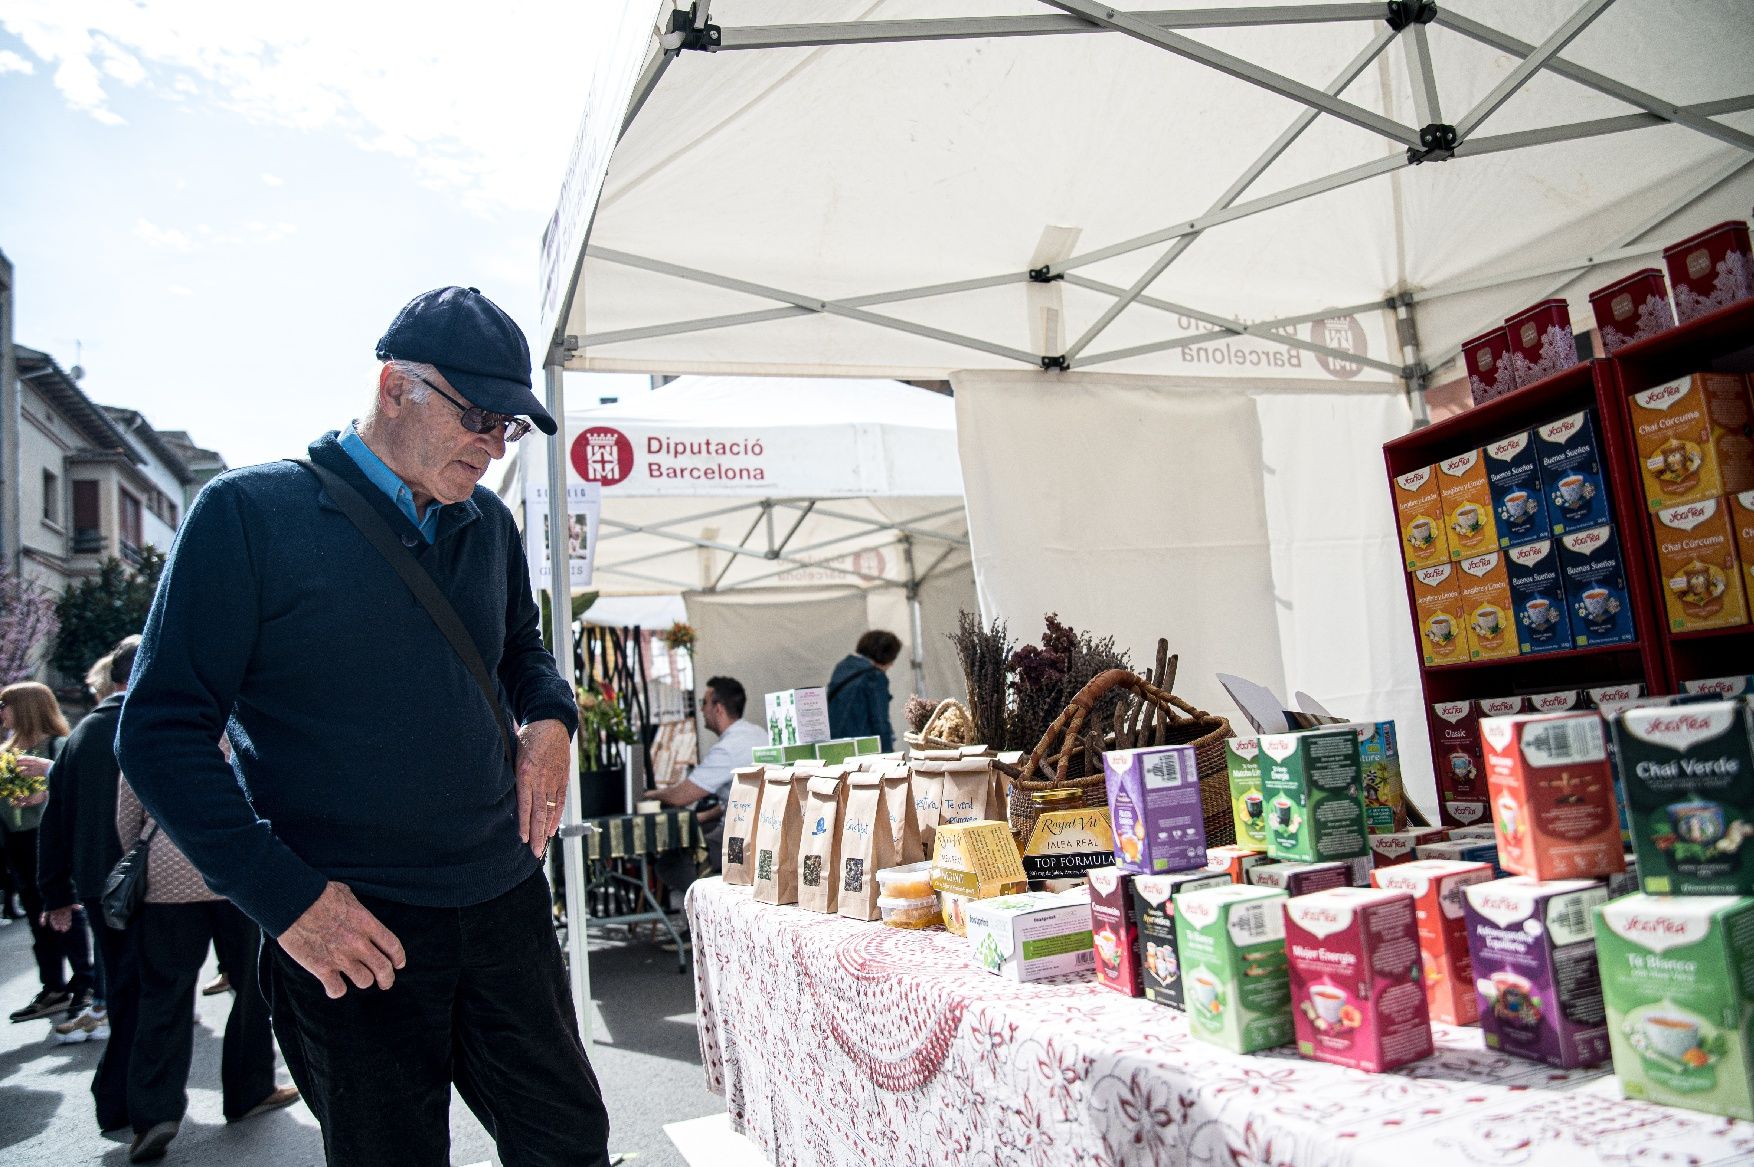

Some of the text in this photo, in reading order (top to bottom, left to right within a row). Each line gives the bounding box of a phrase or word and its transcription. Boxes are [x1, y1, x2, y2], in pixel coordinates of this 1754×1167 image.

[647, 436, 763, 459] Diputació
[648, 462, 764, 480] Barcelona
[1445, 729, 1466, 738] Classic
[1636, 756, 1740, 779] Chai Verde
[945, 799, 955, 809] Te
[1042, 816, 1076, 836] Royal
[1047, 838, 1099, 850] JALEA REAL
[1035, 854, 1116, 868] TOP FÓRMULA
[1646, 954, 1698, 972] Blanco
